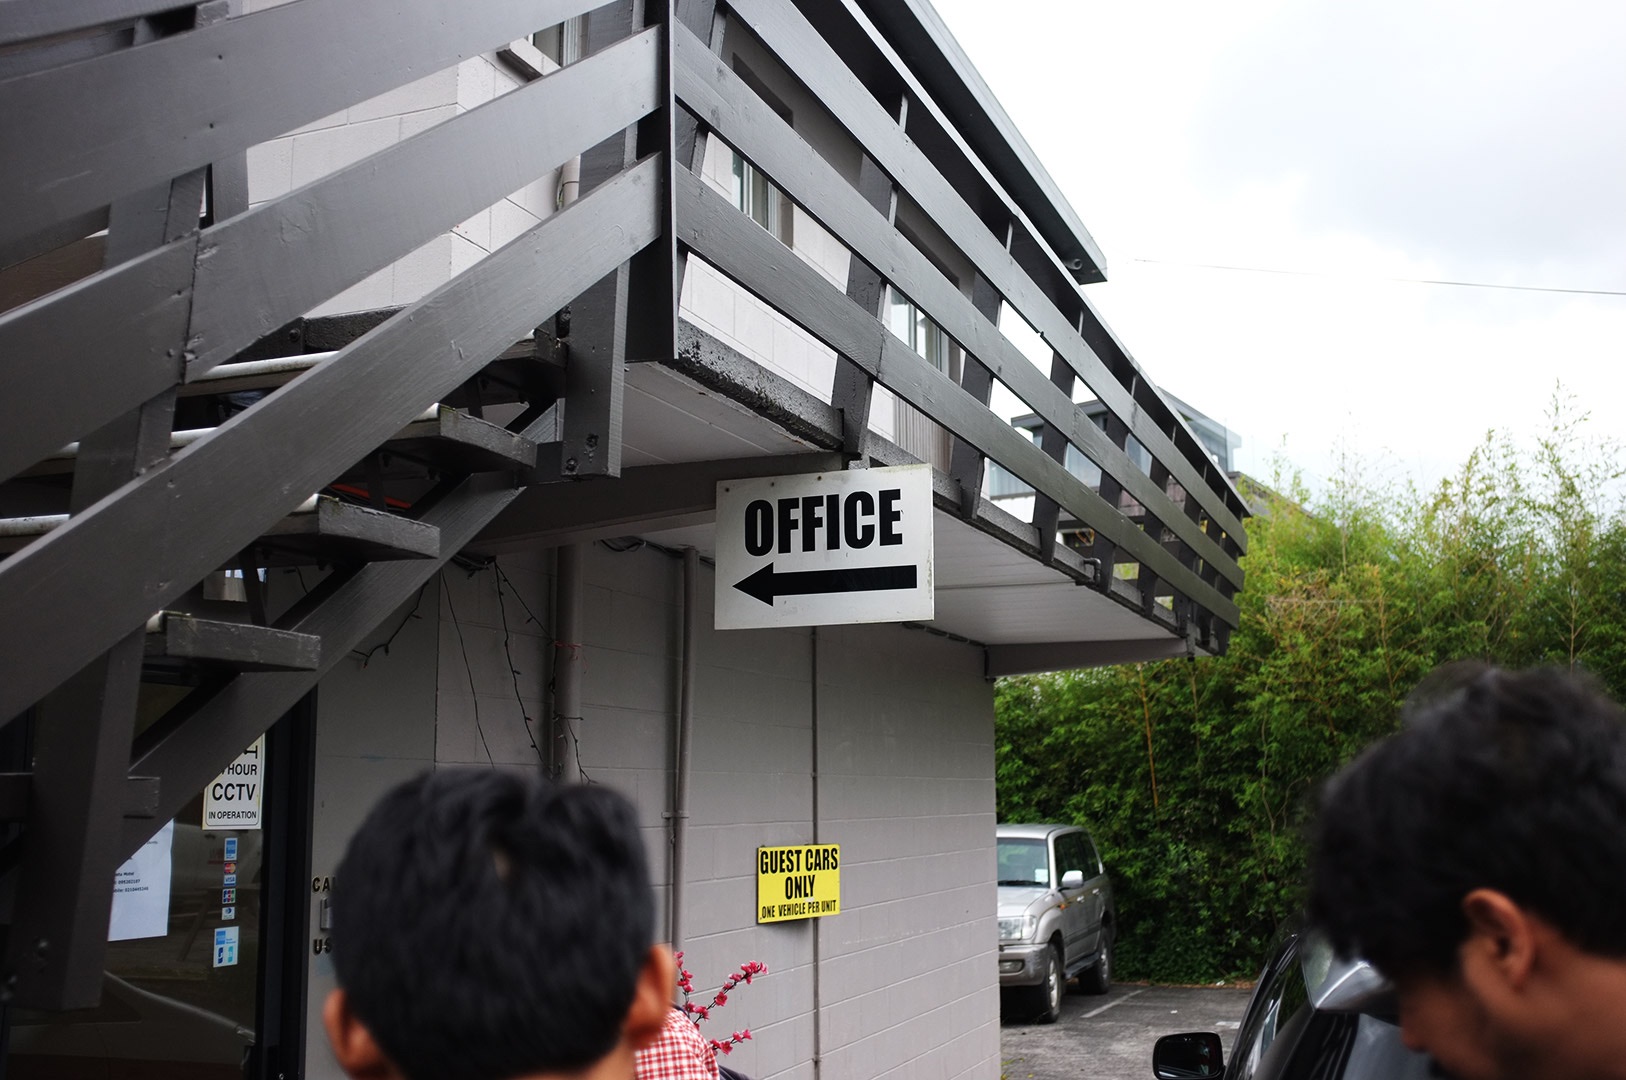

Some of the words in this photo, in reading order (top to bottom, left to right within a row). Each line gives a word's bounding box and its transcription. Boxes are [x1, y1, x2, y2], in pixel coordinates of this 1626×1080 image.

[744, 488, 903, 557] OFFICE
[227, 763, 258, 776] HOUR
[212, 783, 256, 801] CCTV
[208, 811, 216, 820] IN
[217, 810, 257, 820] OPERATION
[760, 849, 802, 875] GUEST
[805, 847, 838, 872] CARS
[785, 874, 816, 900] ONLY
[761, 905, 776, 919] ONE
[778, 902, 806, 917] VEHICLE
[807, 901, 820, 914] PER
[821, 899, 837, 913] UNIT
